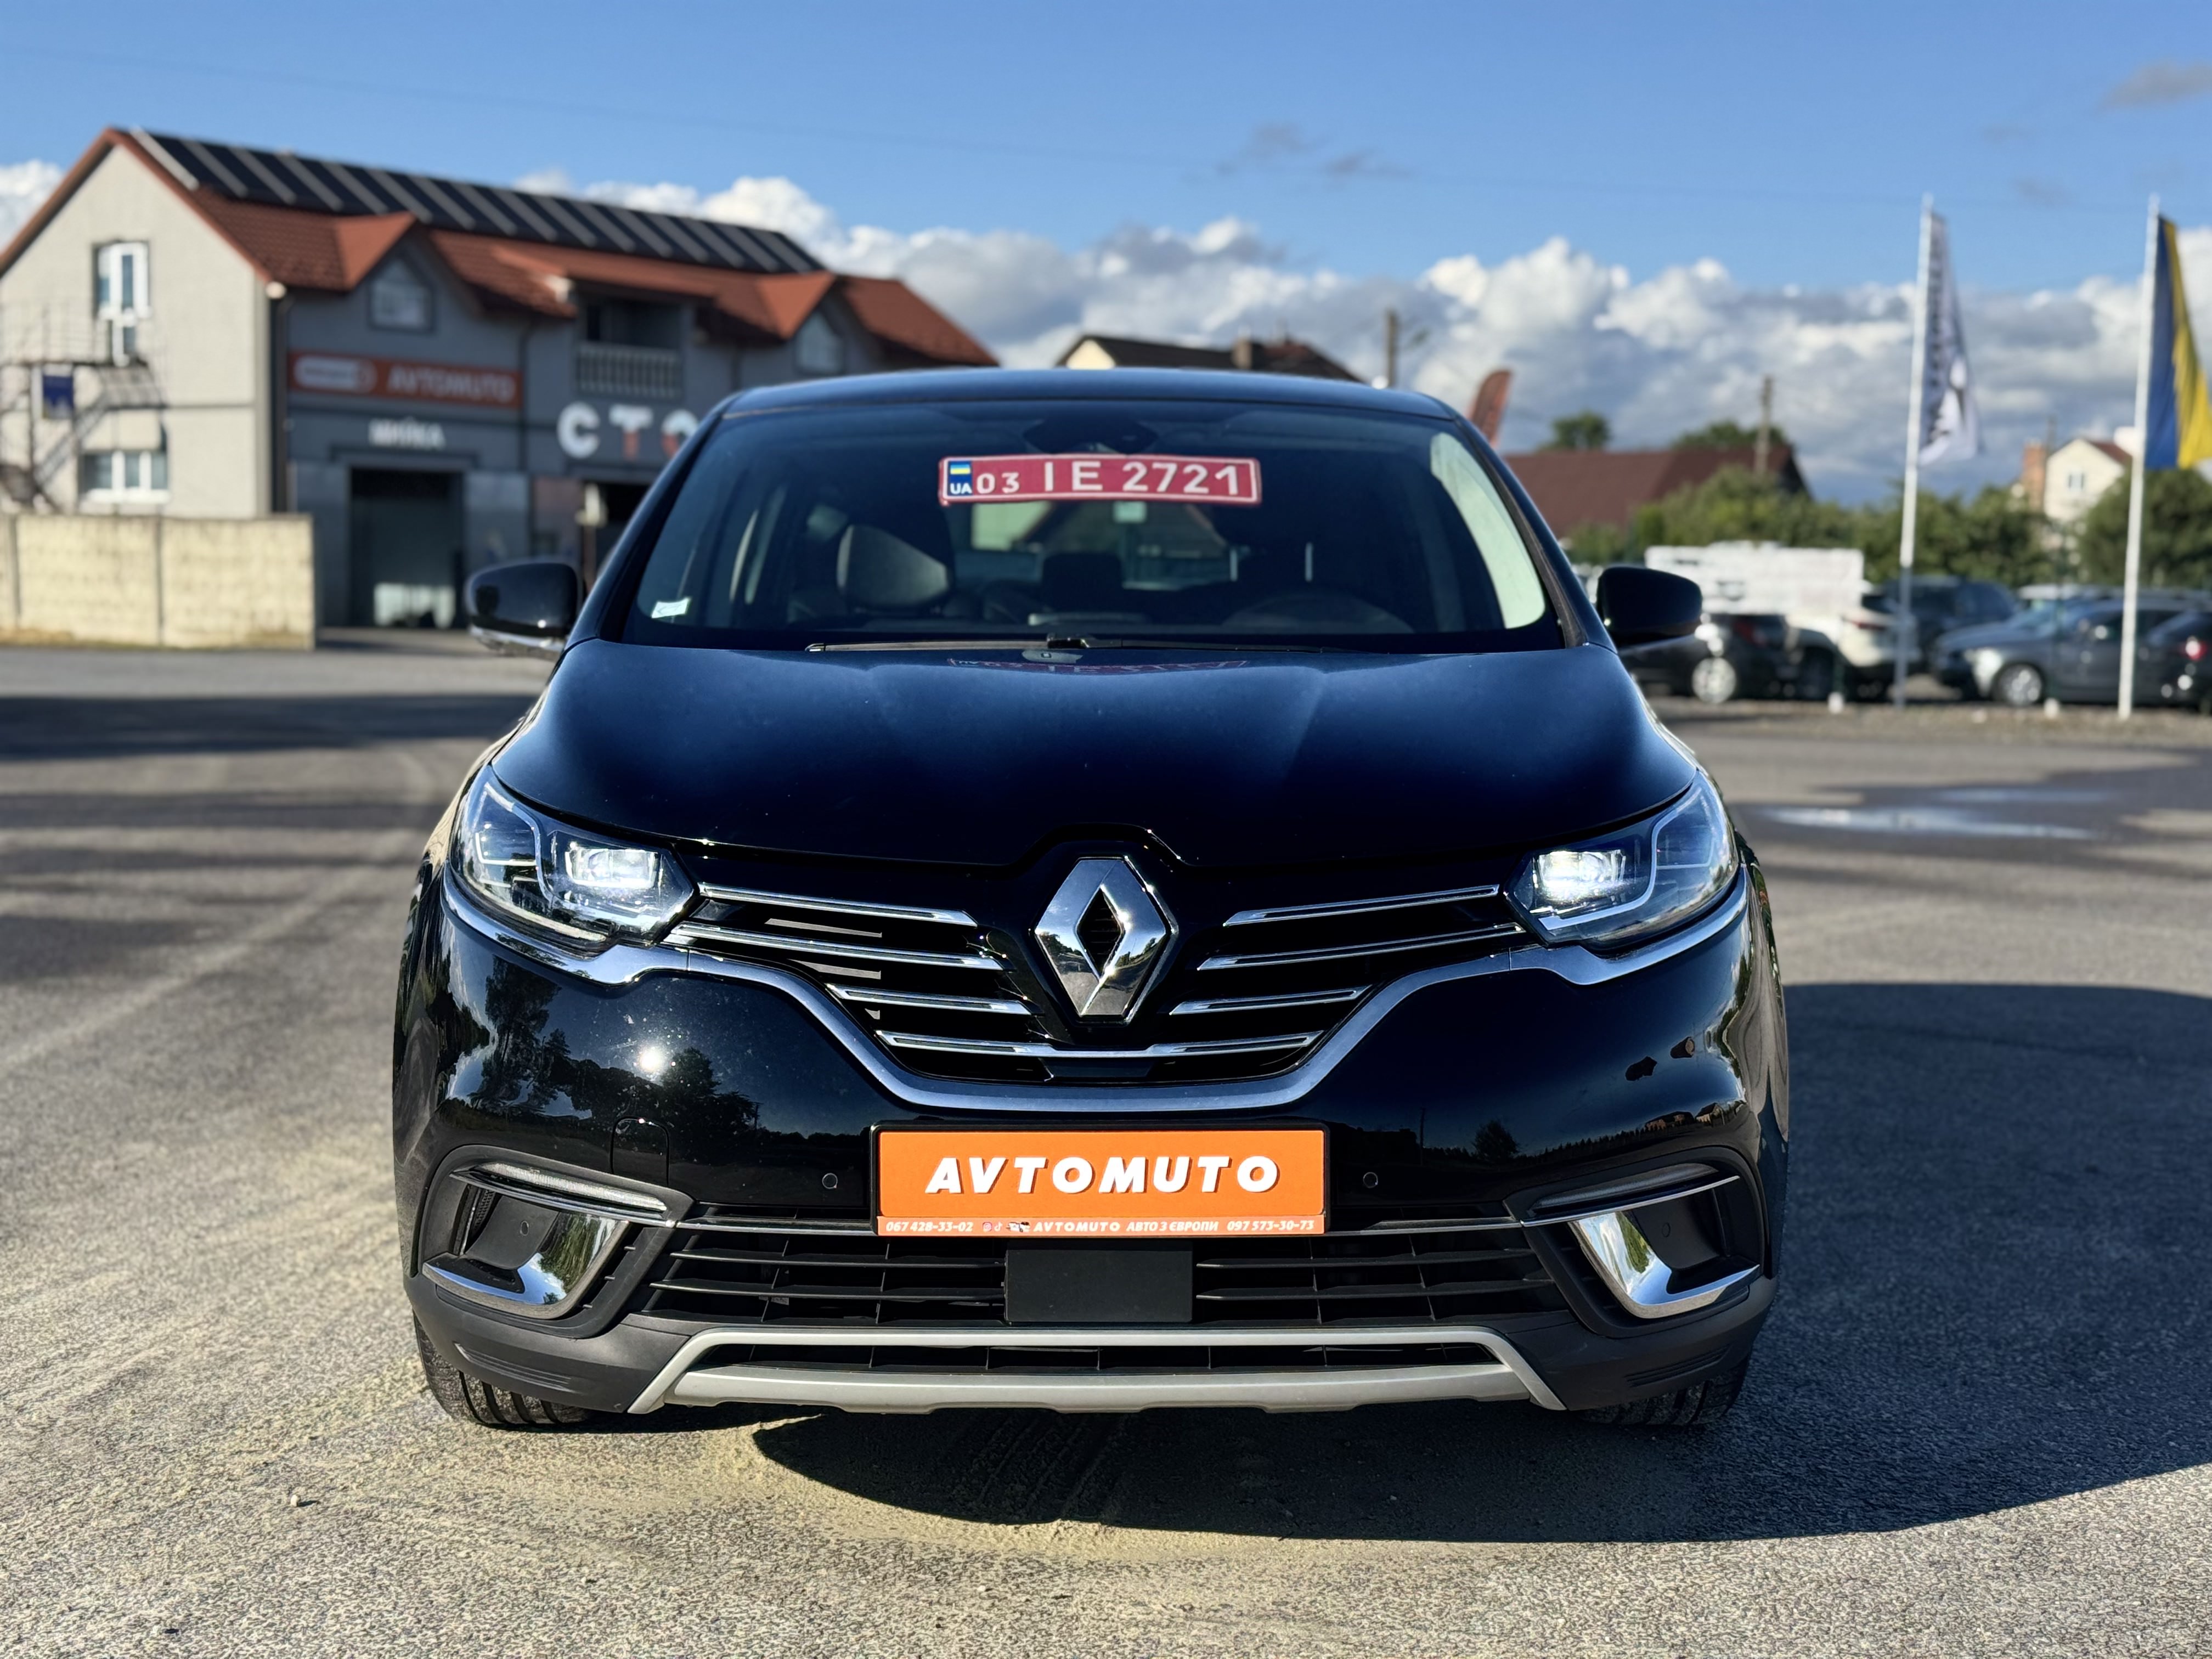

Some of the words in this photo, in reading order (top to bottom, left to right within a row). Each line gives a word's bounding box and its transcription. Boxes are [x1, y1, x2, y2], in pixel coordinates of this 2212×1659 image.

[388, 364, 516, 402] AVTOMUTO
[976, 472, 1020, 494] 03
[1044, 460, 1103, 492] IE
[1122, 461, 1238, 495] 2721
[950, 483, 972, 494] UA
[925, 1156, 1280, 1194] AVTOMUTO
[886, 1221, 909, 1232] 067
[910, 1221, 974, 1232] 428-33-02
[1033, 1221, 1121, 1232] AVTOMUTO
[1126, 1221, 1158, 1232] АВТО
[1169, 1221, 1219, 1231] ЄВРОПИ
[1227, 1221, 1251, 1231] 097
[1251, 1220, 1314, 1231] 573-30-73
